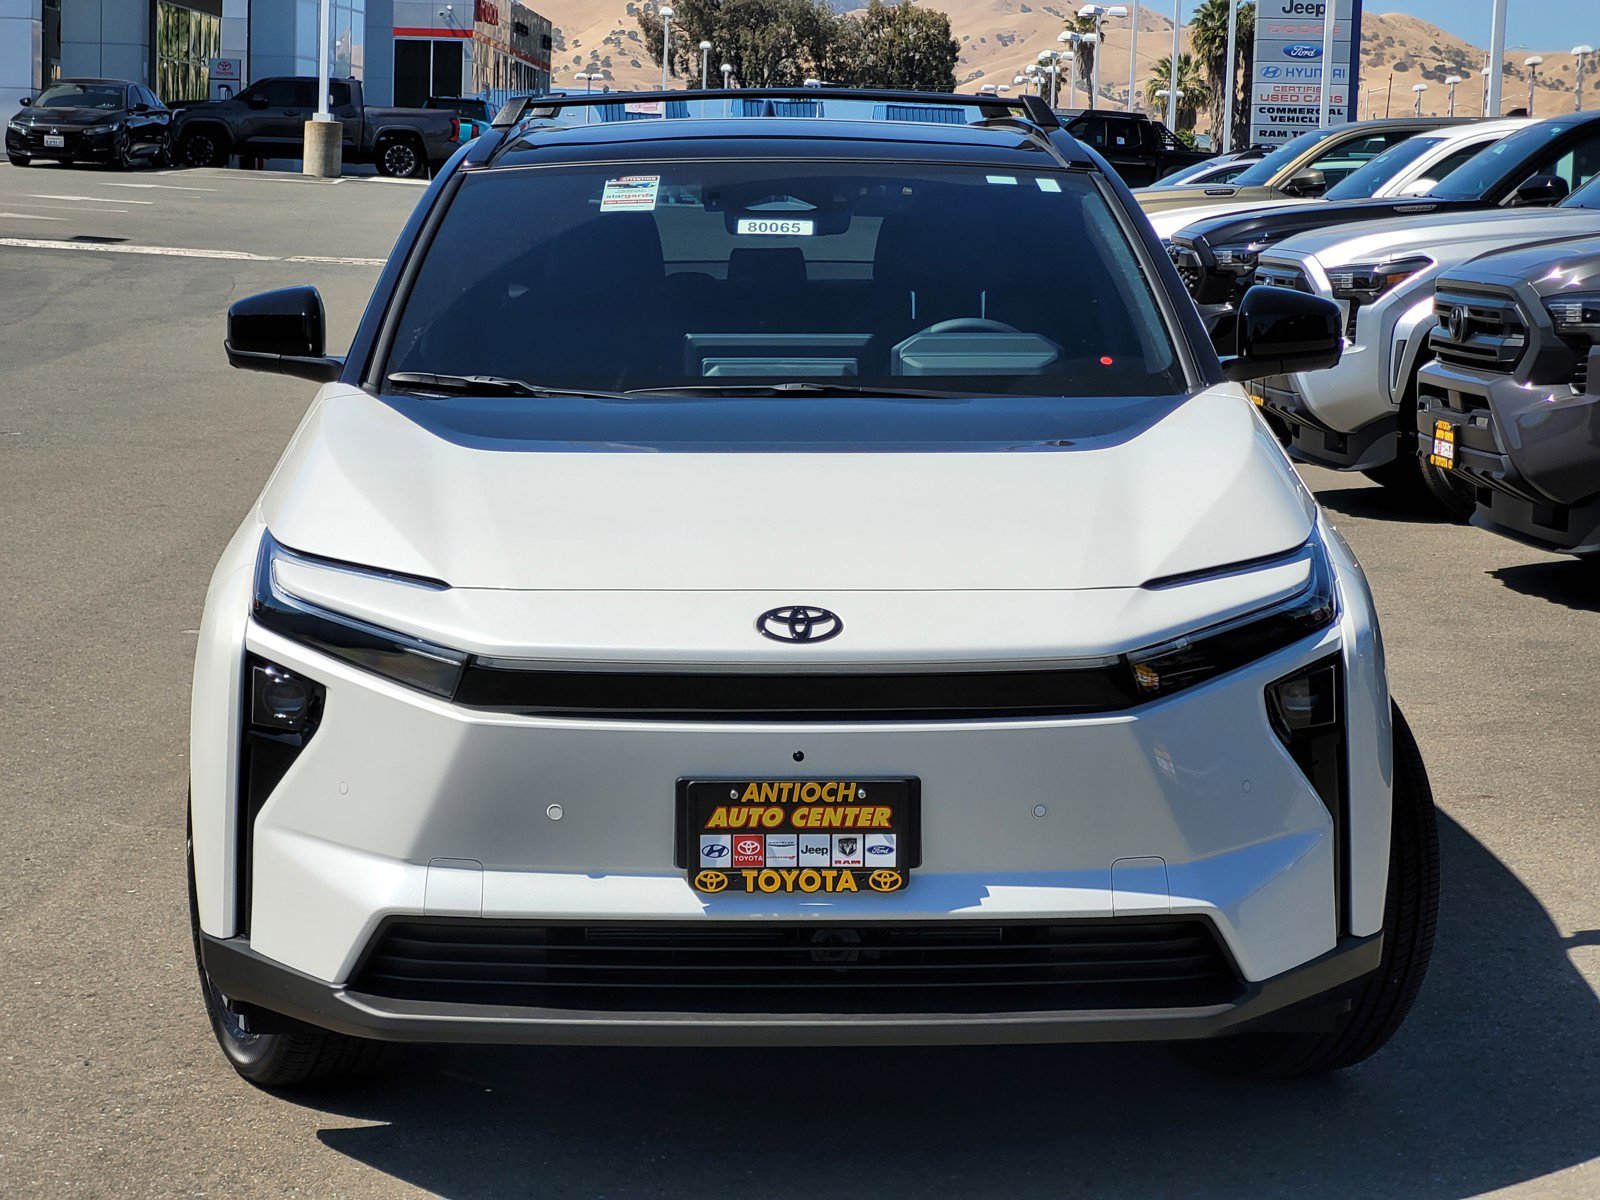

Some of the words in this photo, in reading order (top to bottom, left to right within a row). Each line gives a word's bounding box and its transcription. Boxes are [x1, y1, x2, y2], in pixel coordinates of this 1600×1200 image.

[1281, 0, 1325, 17] Jeep
[1290, 45, 1316, 57] Ford
[1285, 68, 1345, 78] HYUNAI
[1260, 94, 1300, 103] USED
[1259, 107, 1343, 115] COMMERCAL
[1258, 130, 1287, 138] RAM
[747, 221, 801, 233] 80065
[741, 782, 857, 803] ANTIOCH
[706, 806, 784, 828] AUTO
[792, 806, 892, 828] CENTER
[801, 845, 828, 856] Jeep
[871, 846, 890, 854] Ford
[741, 869, 858, 893] TOYOTA
